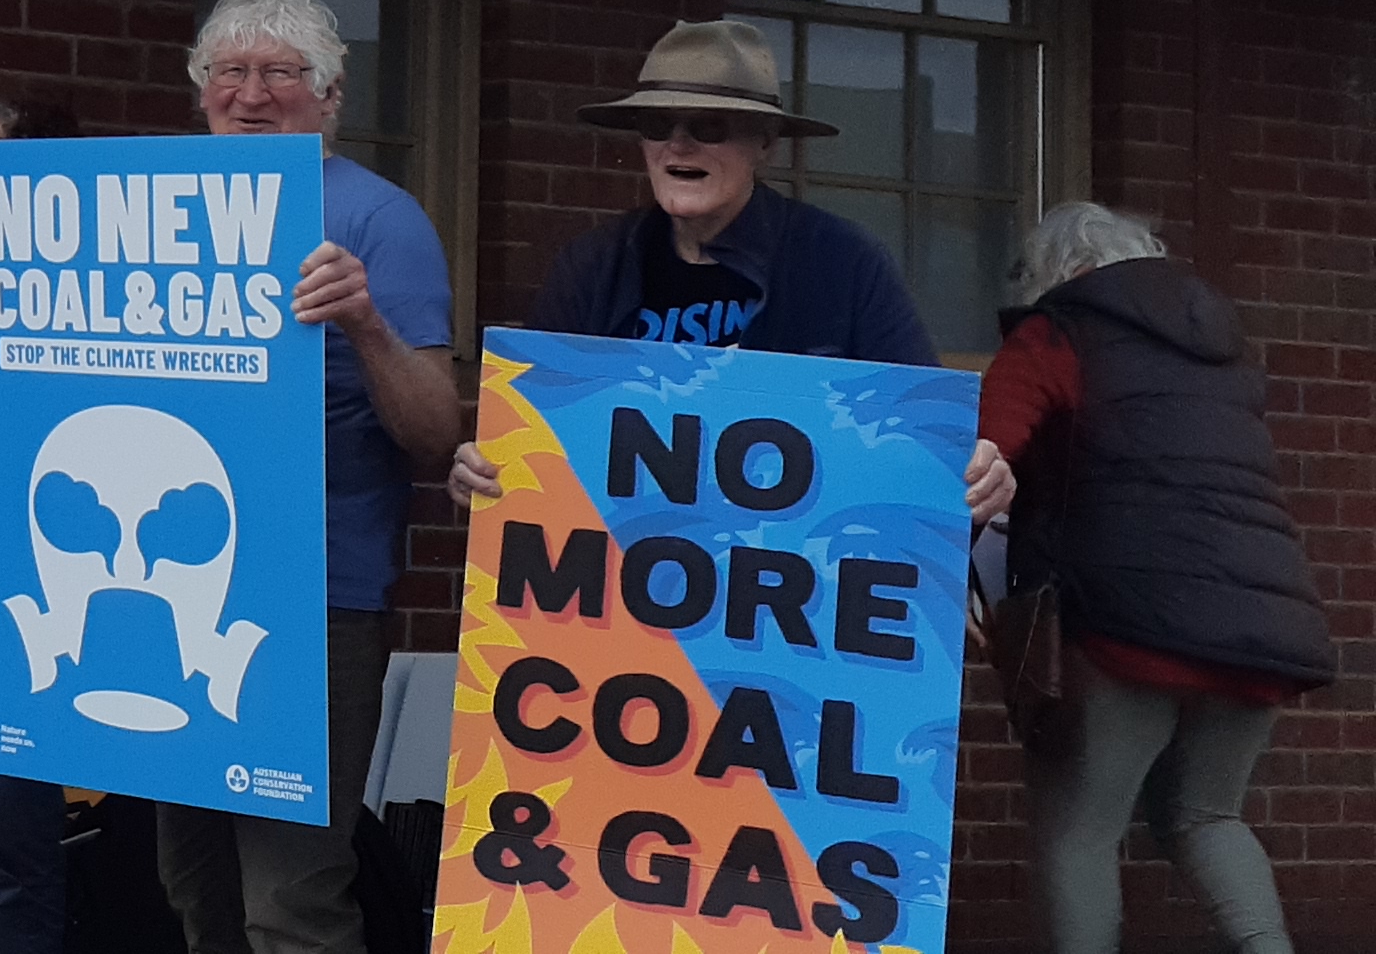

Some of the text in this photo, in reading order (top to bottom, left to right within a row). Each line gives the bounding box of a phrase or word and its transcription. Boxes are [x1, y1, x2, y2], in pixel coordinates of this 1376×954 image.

[96, 173, 282, 265] NEW
[6, 344, 260, 375] STOP THE CLIMATE WRECKERS
[607, 406, 815, 511] NO
[496, 520, 919, 661] MORE
[253, 767, 303, 783] AUSTRALIAN
[493, 656, 900, 804] COAL
[253, 777, 313, 794] CONSERVATION
[253, 787, 305, 803] FOUNDATION
[473, 791, 900, 943] & GAS
